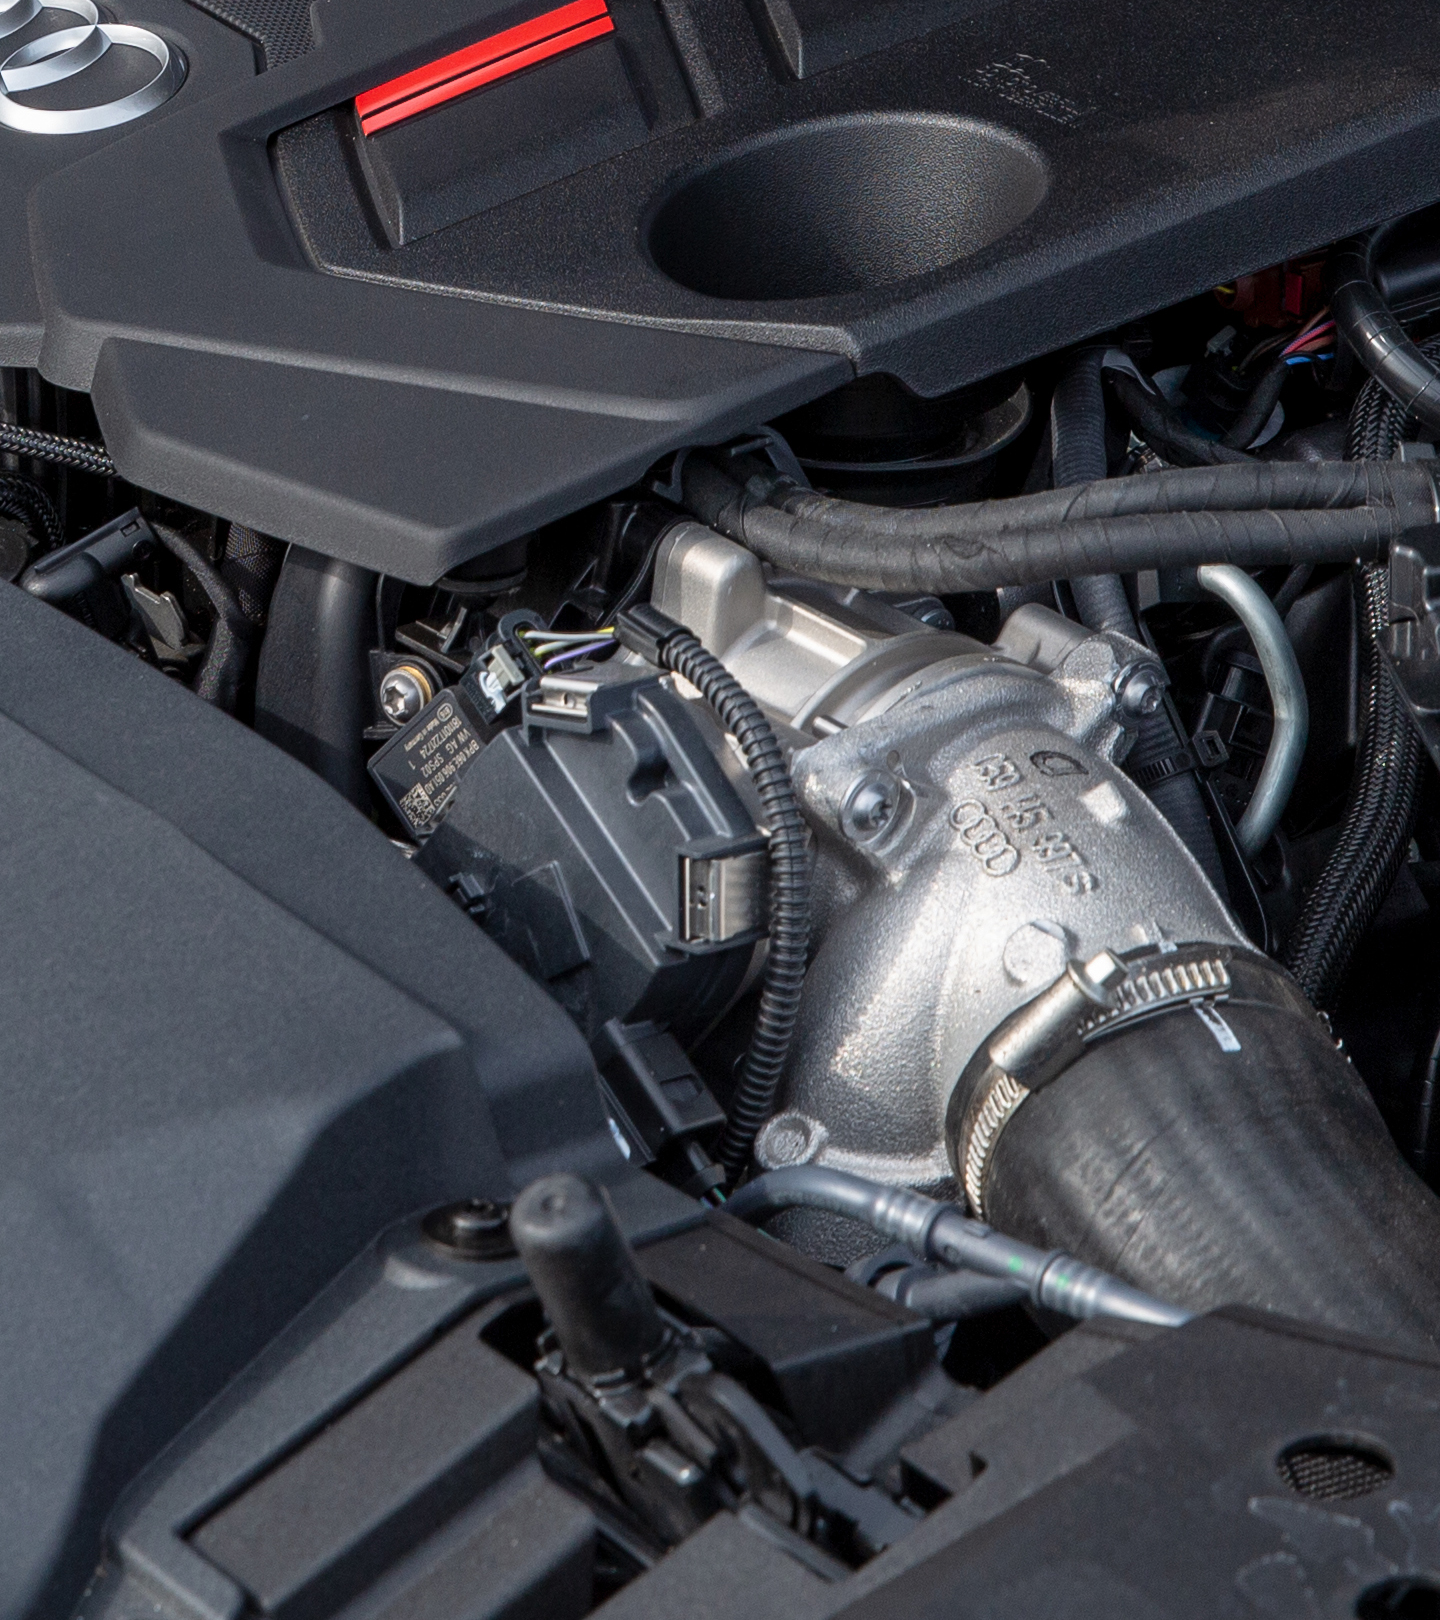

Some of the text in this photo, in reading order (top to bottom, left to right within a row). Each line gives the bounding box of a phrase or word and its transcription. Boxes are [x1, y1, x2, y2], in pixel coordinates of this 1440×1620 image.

[425, 717, 440, 731] Made
[403, 731, 424, 752] Germany
[419, 727, 471, 778] VW AG SPS02
